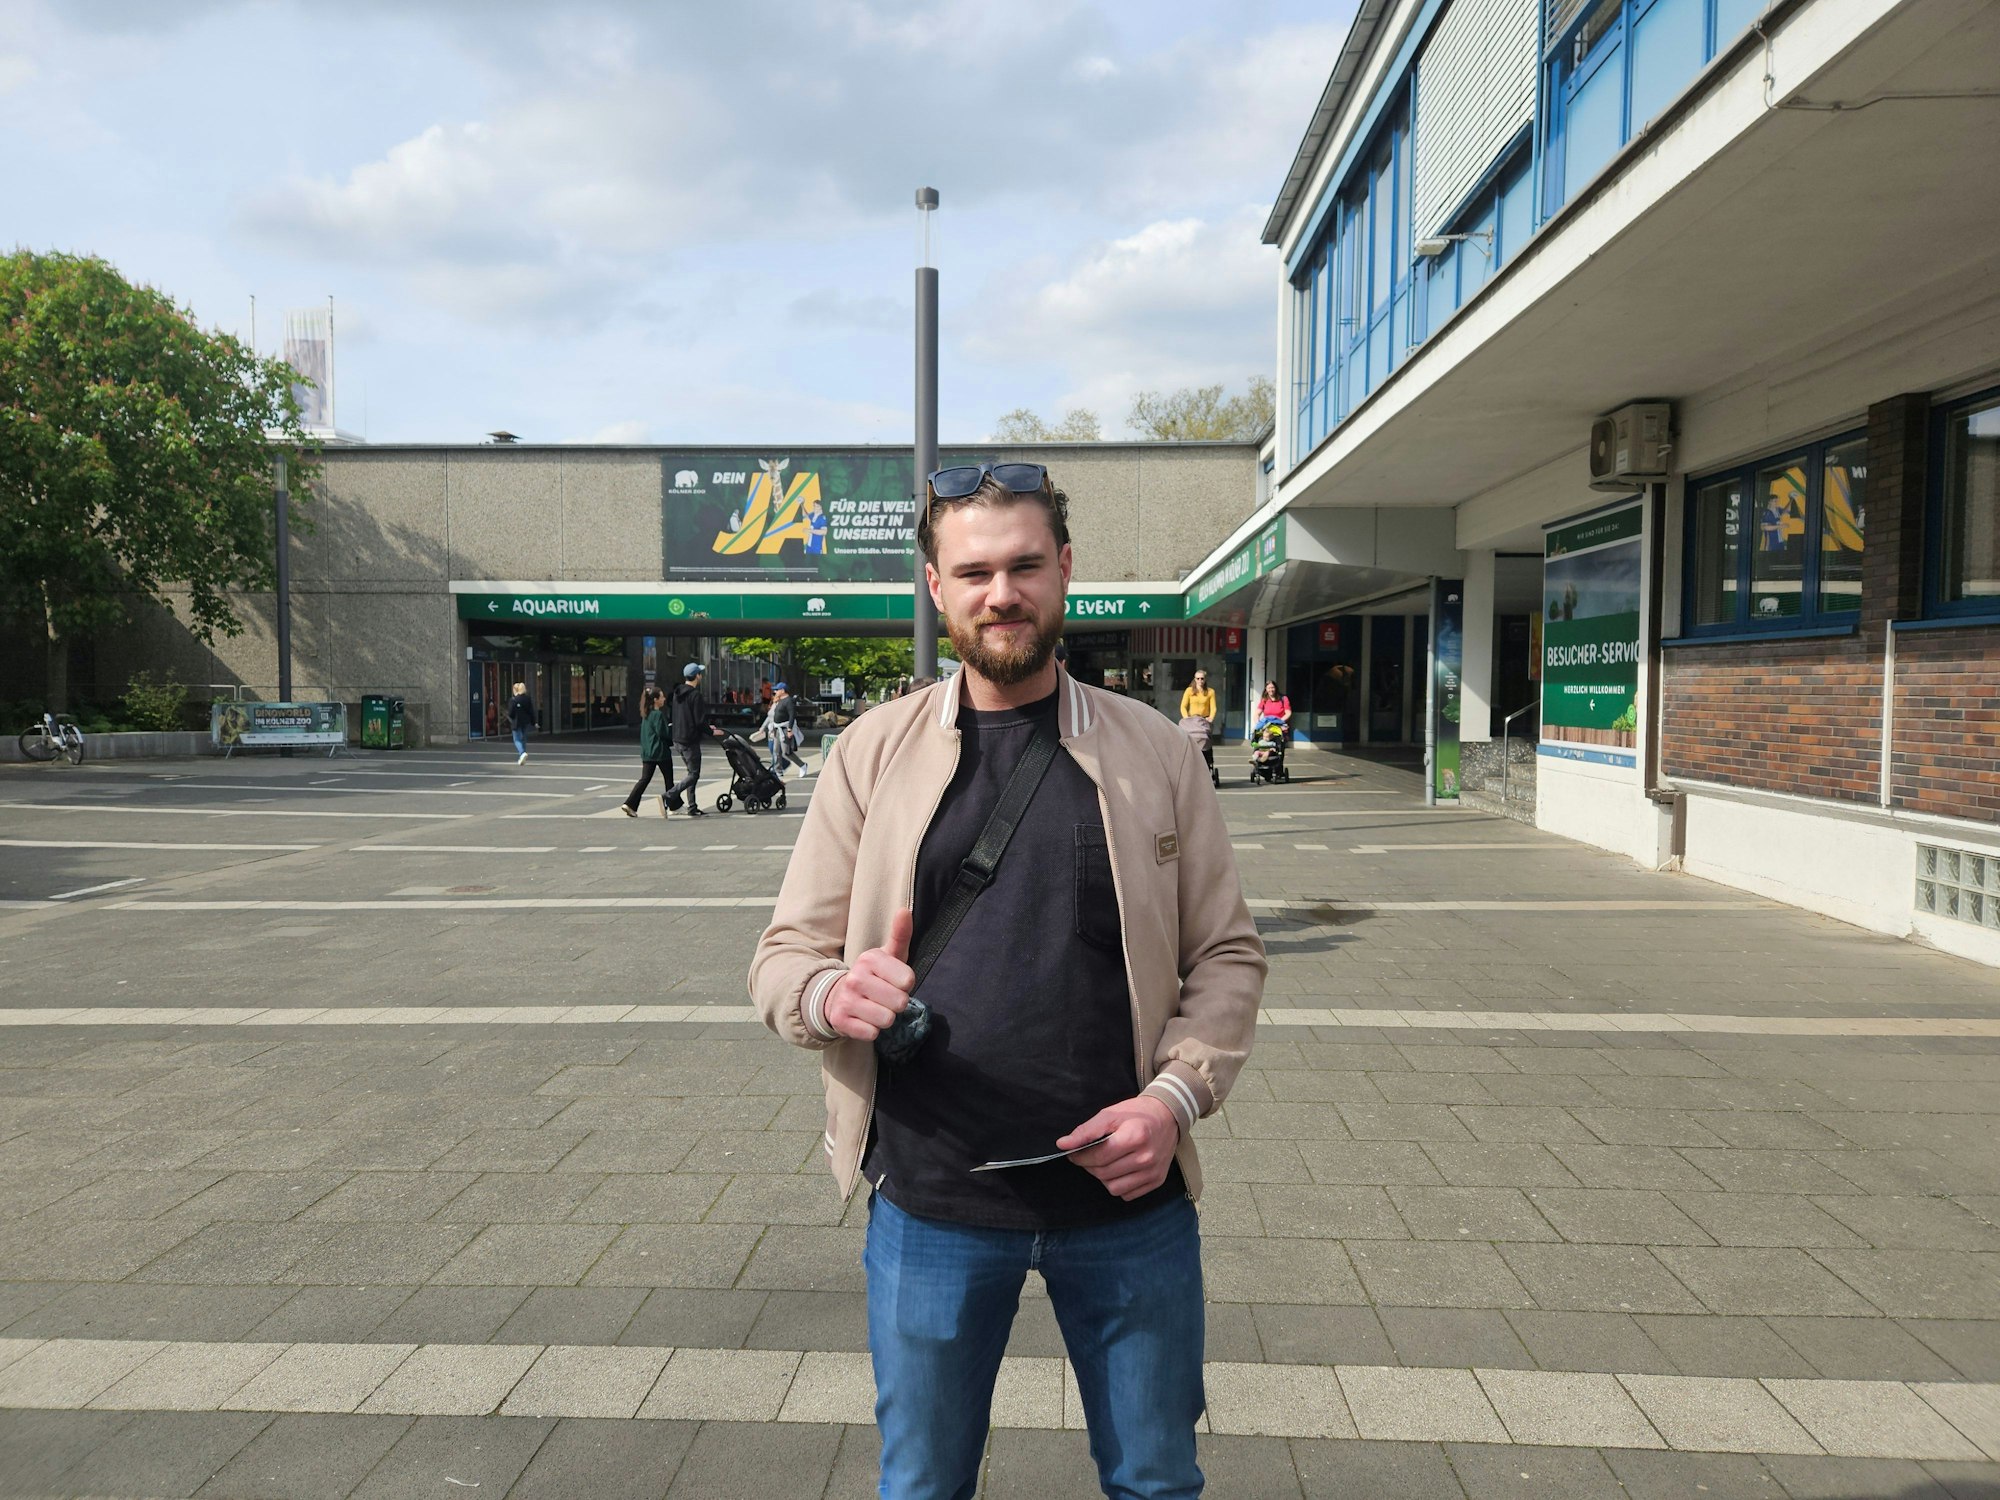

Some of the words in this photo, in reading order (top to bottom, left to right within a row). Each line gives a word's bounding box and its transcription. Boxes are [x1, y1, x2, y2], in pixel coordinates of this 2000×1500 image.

[712, 472, 746, 485] DEIN
[829, 498, 857, 513] FÜR
[858, 501, 881, 513] DIE
[882, 501, 915, 513] WELT
[712, 472, 828, 555] JA
[830, 514, 850, 527] ZU
[851, 514, 888, 527] GAST
[888, 514, 904, 527] IN
[833, 528, 896, 541] UNSEREN
[897, 528, 916, 541] VE
[512, 598, 600, 616] AQUARIUM
[1076, 599, 1126, 615] EVENT
[1563, 685, 1588, 694] HERZLICH
[1589, 685, 1626, 695] WILLKOMMEN
[255, 708, 312, 717] DINOWORLD
[266, 716, 295, 725] KÖLNER
[296, 717, 312, 725] ZOO
